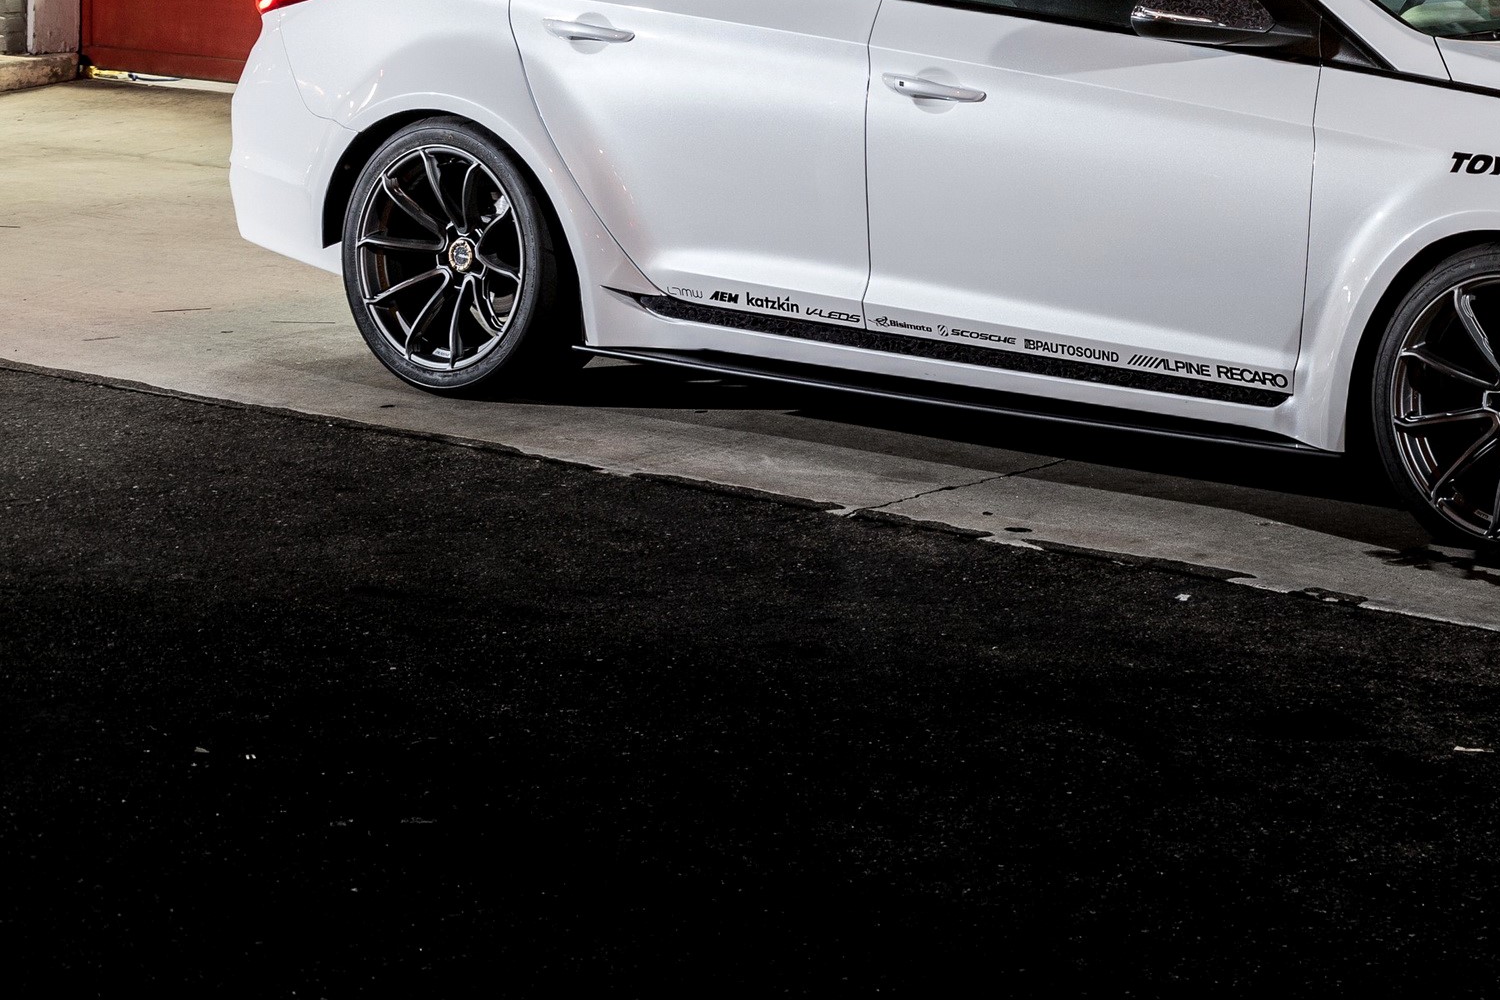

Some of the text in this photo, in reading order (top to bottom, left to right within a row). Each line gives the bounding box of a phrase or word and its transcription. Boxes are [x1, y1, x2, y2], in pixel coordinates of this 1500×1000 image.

[709, 291, 739, 304] AEM
[746, 292, 800, 314] katzkin
[950, 328, 1017, 345] SCOSCHE
[1217, 366, 1288, 389] RECARO
